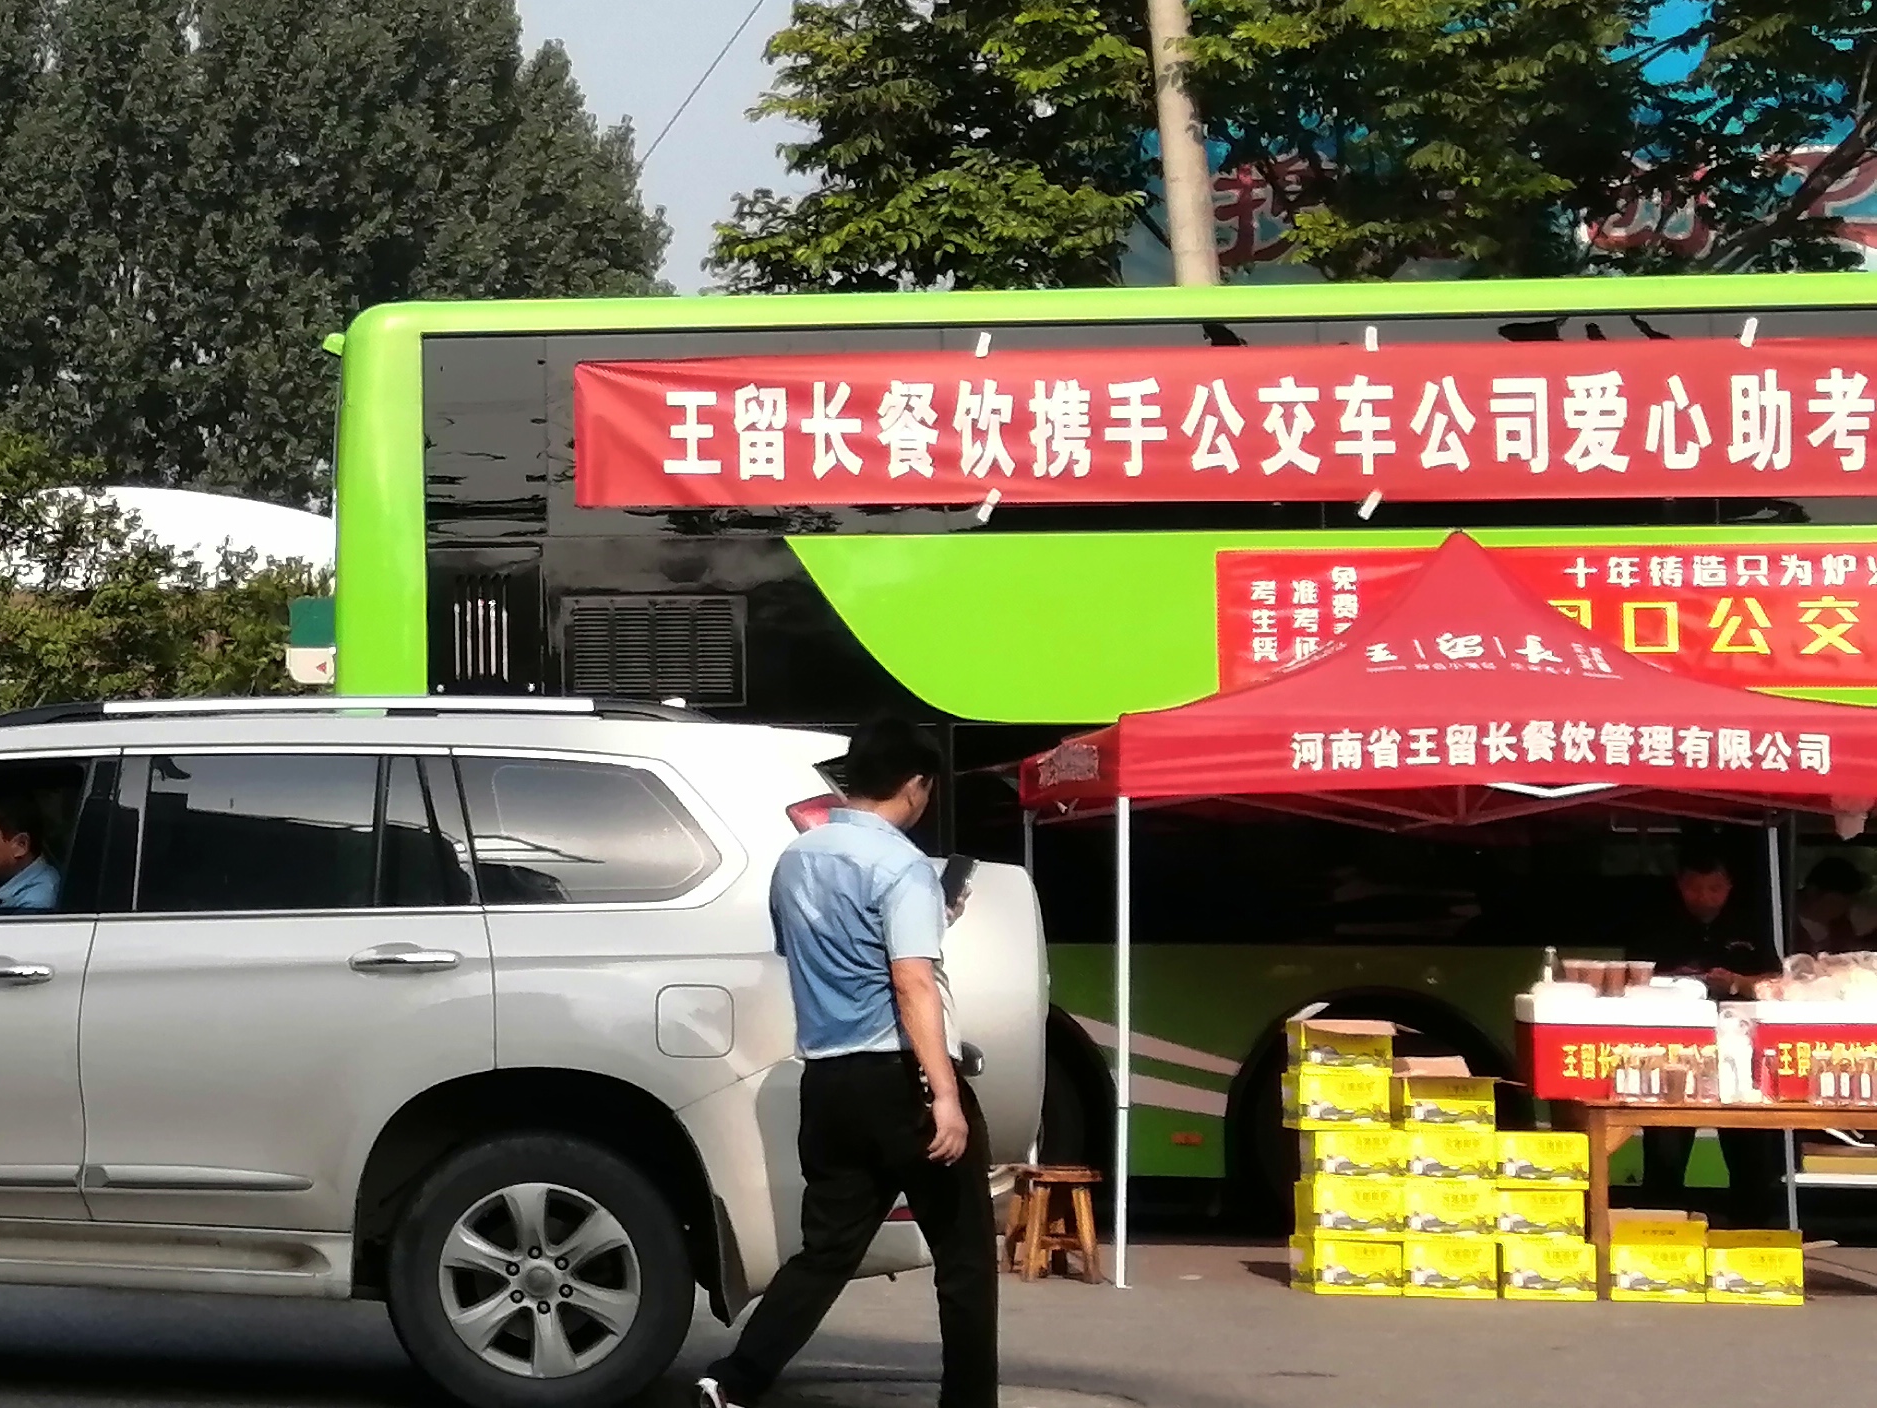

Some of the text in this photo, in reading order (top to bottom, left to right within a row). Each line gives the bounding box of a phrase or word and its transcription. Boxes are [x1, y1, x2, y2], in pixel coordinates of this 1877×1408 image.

[662, 367, 1876, 481] 王留长餐饮携手公交车公司爱心助考
[1290, 719, 1831, 776] 河南省王留长餐饮管理有限公司
